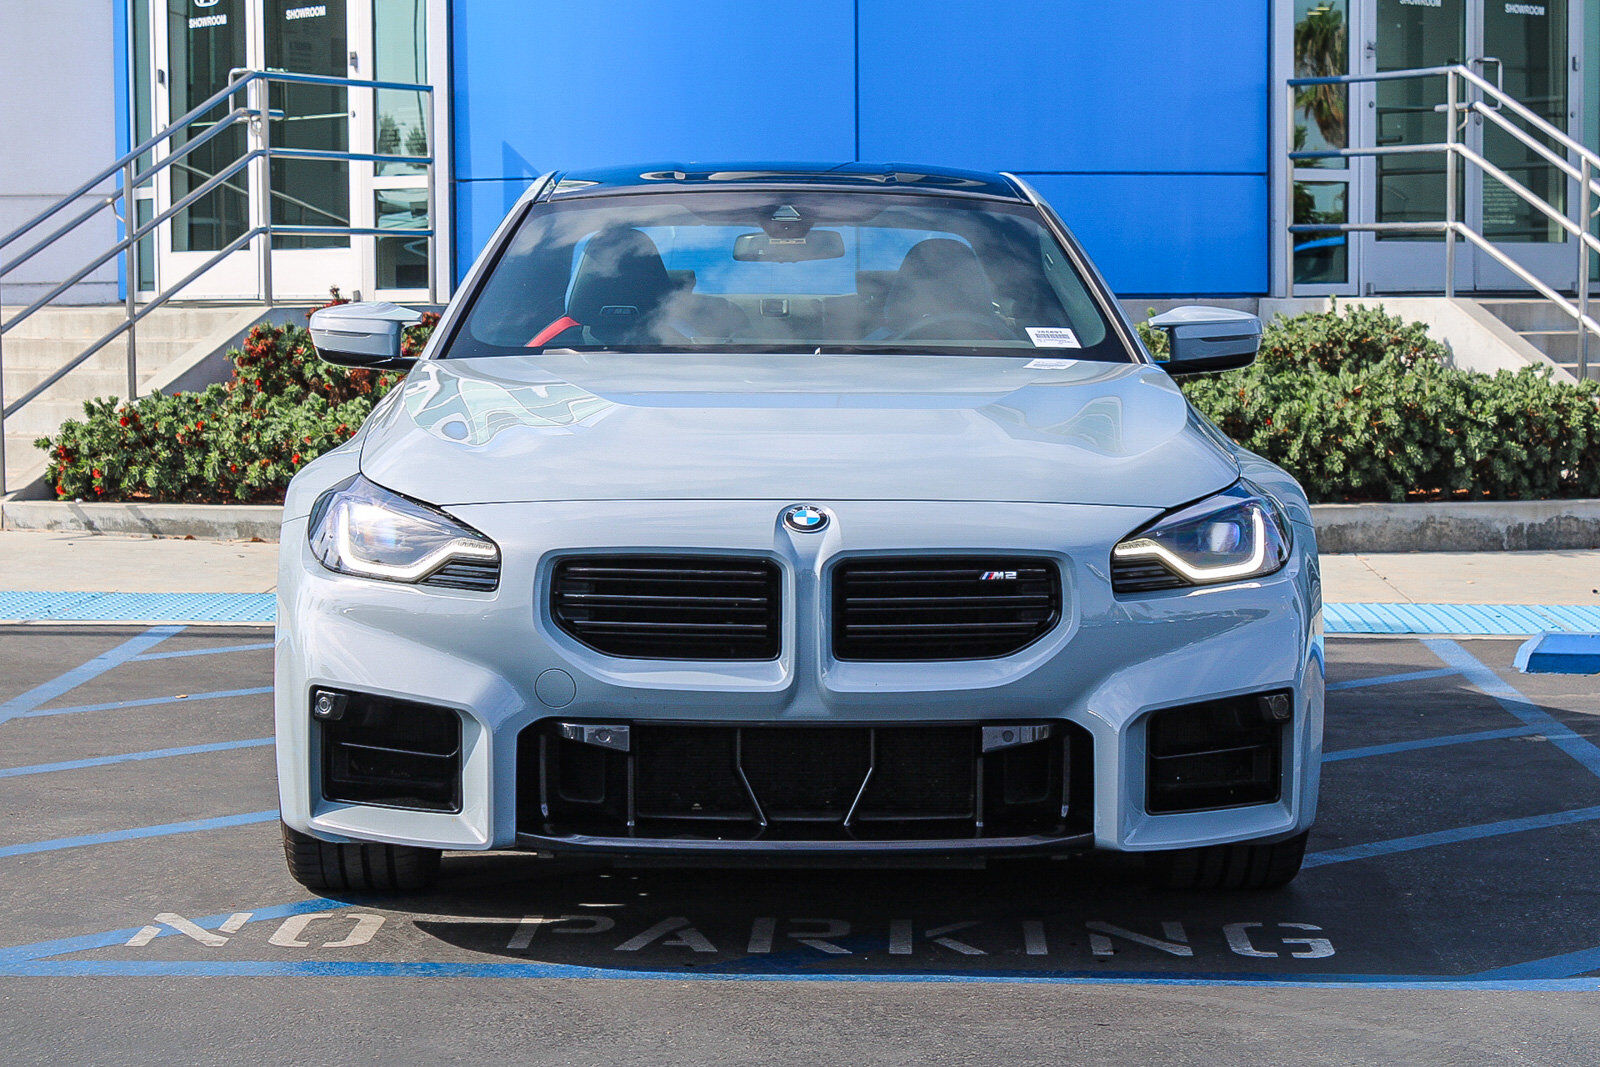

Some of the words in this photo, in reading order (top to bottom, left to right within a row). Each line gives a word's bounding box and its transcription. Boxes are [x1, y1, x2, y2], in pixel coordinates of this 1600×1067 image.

[286, 5, 326, 20] SHOWROOM
[1505, 3, 1545, 15] SHOWROOM
[189, 14, 227, 28] SHOWROOM
[125, 913, 387, 947] NO
[506, 914, 1336, 958] PARKING
